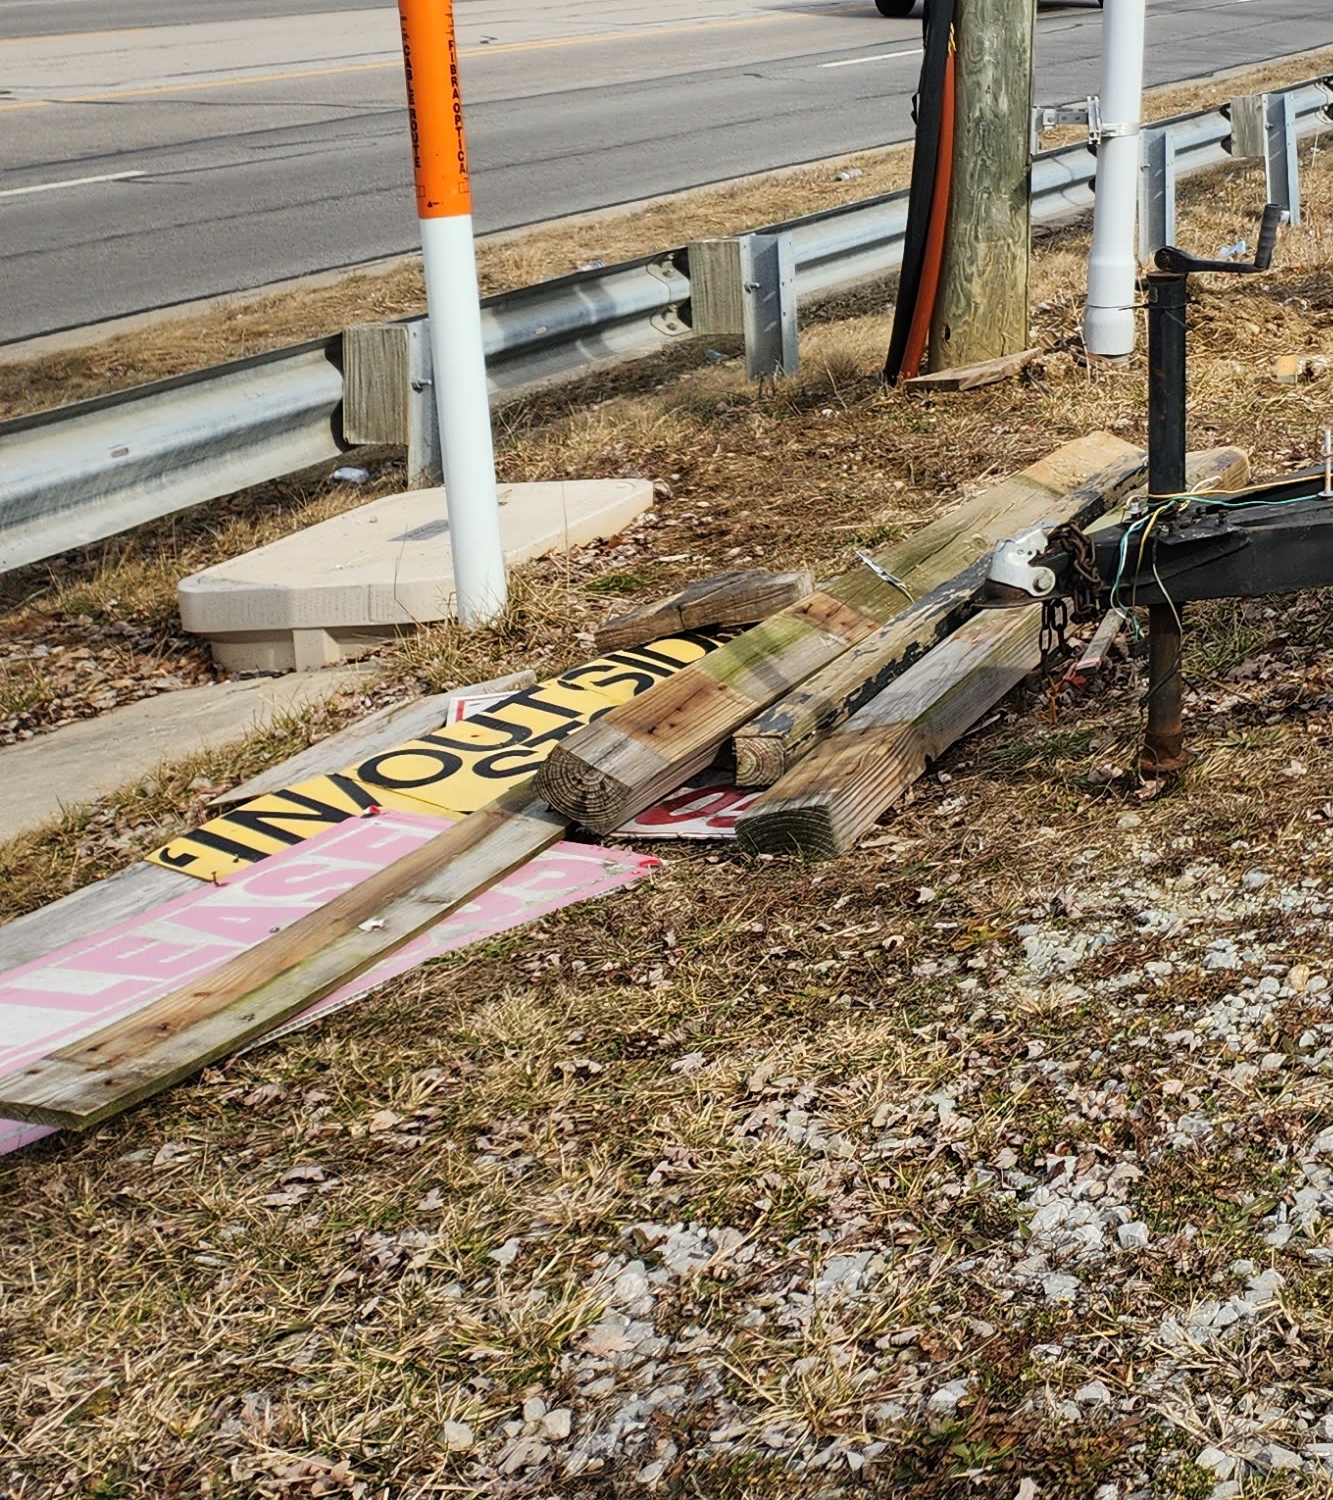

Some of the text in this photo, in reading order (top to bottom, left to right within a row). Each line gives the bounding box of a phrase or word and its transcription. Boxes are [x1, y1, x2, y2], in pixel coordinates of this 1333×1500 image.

[448, 39, 459, 99] FIBRA
[403, 45, 414, 106] CABLE
[410, 108, 421, 168] ROUTE
[453, 102, 466, 174] OPTICA
